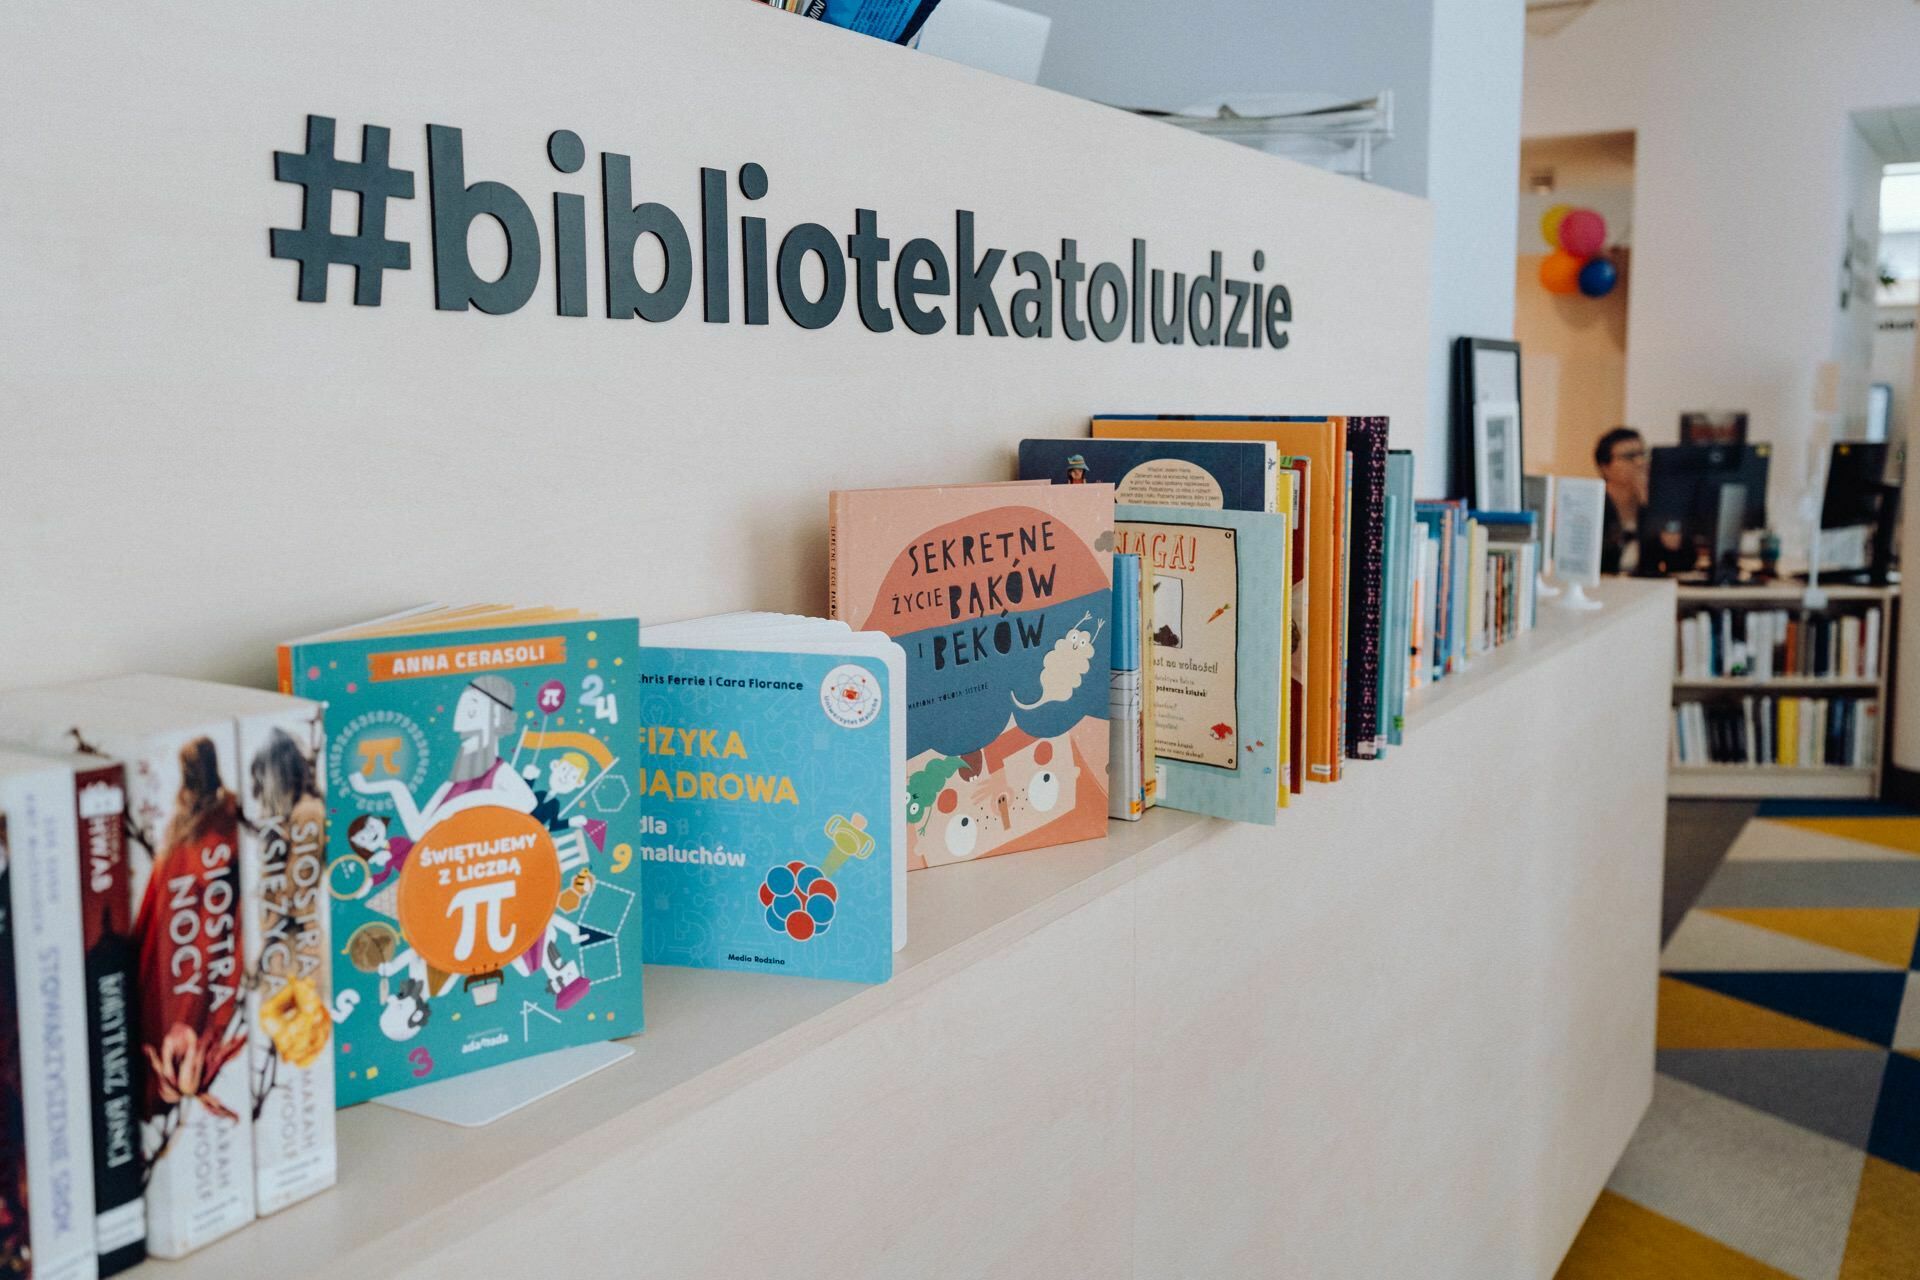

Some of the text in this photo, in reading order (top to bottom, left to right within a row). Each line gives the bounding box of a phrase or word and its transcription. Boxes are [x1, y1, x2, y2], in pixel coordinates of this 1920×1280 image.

[269, 114, 1292, 350] #bibliotekatoludzie
[909, 521, 1055, 576] SEKRETNE
[892, 558, 1056, 619] ŻYCIE BĄKÓW
[392, 645, 545, 675] ANNA CERASOLI
[918, 608, 1045, 670] I BEKÓW
[640, 674, 804, 691] hris Ferrie i Cara Florance
[640, 767, 800, 805] JĄDROWA
[420, 832, 537, 868] ŚWIĘTUJEMY
[438, 857, 521, 885] Z LICZBĄ
[291, 821, 321, 978] SIOSTRA
[168, 874, 204, 996] NOCY
[201, 843, 236, 1012] SIOSTRA
[728, 953, 785, 965] Media Rodzina
